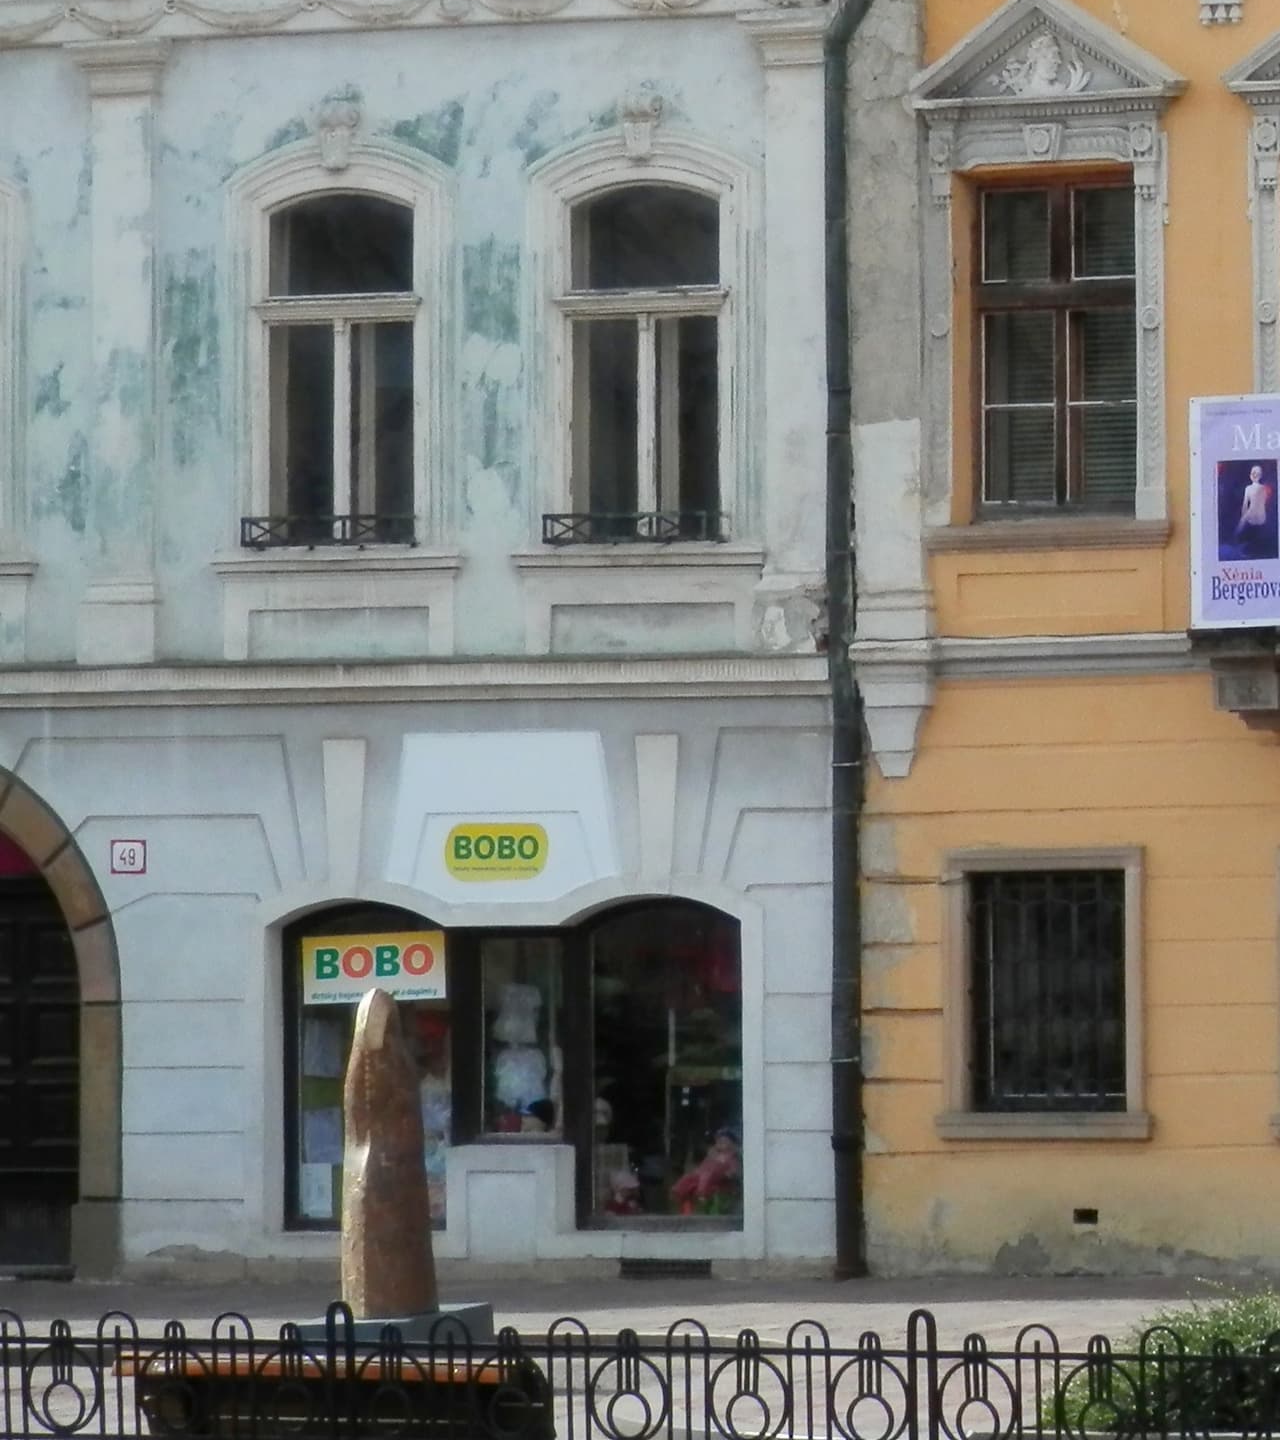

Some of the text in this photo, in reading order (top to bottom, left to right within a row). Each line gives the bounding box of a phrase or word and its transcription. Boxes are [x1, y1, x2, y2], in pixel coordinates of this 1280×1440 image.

[119, 847, 136, 866] 49
[453, 834, 540, 860] BOBO
[315, 943, 435, 980] BOBO
